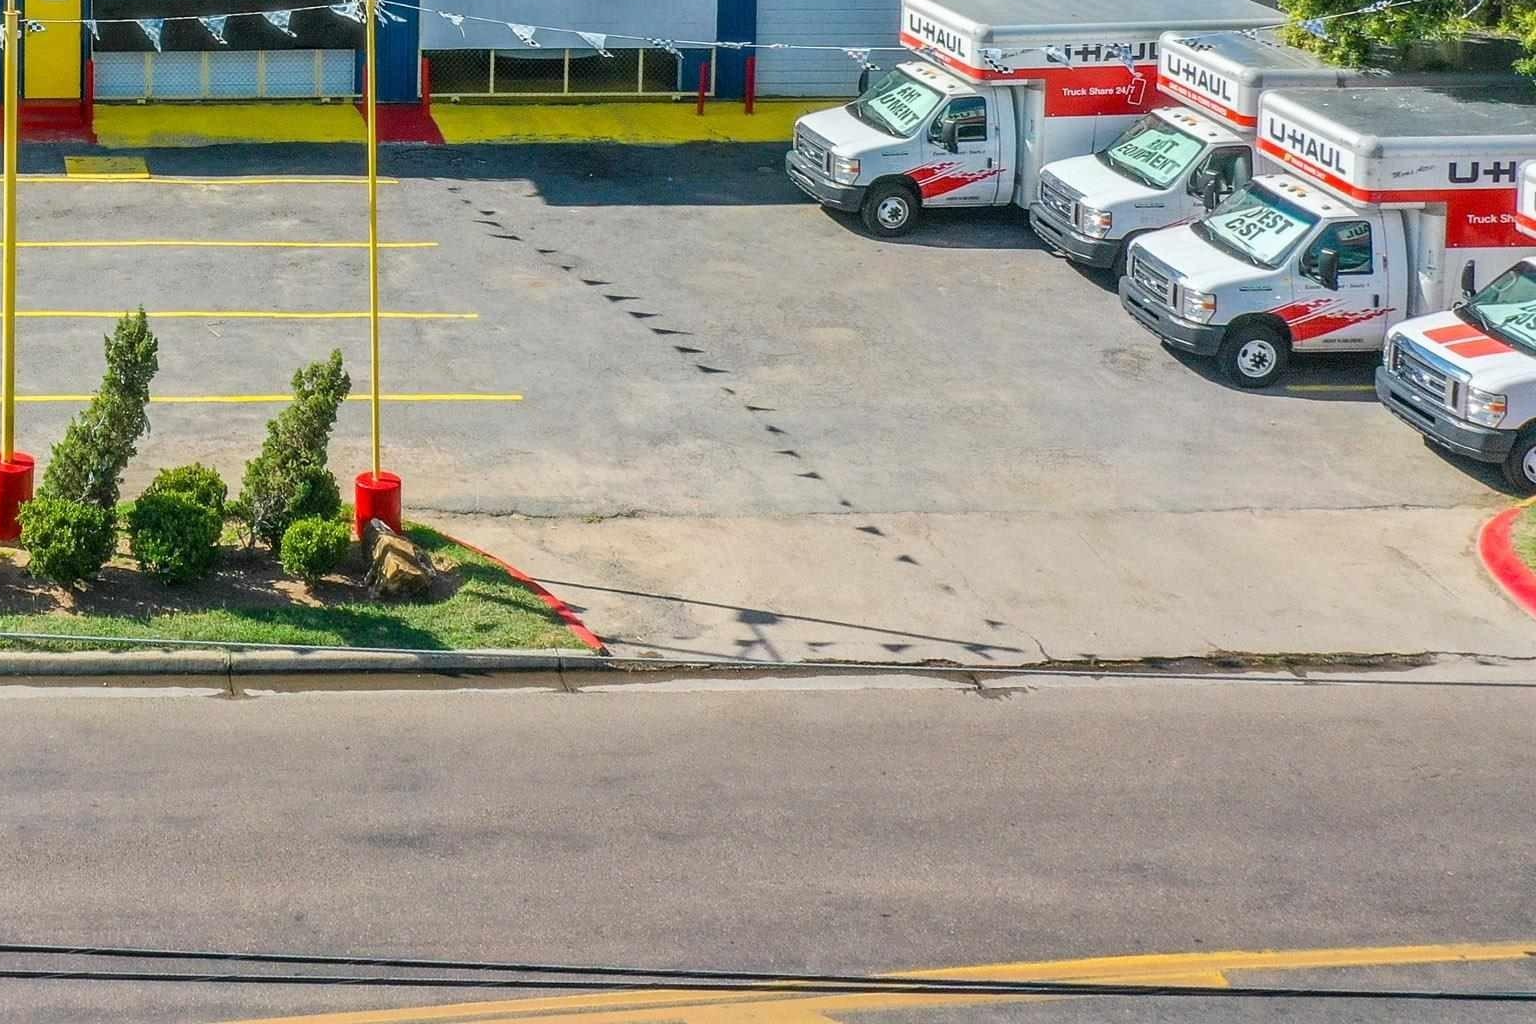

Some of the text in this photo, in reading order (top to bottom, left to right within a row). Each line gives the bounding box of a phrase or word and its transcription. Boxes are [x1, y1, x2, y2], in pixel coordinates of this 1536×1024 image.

[909, 14, 966, 58] U-HAUL
[1063, 85, 1135, 96] Truck Share 24/7
[1168, 54, 1231, 101] U-HAUL
[1270, 118, 1346, 174] U-HAUL
[1467, 214, 1497, 225] Truck
